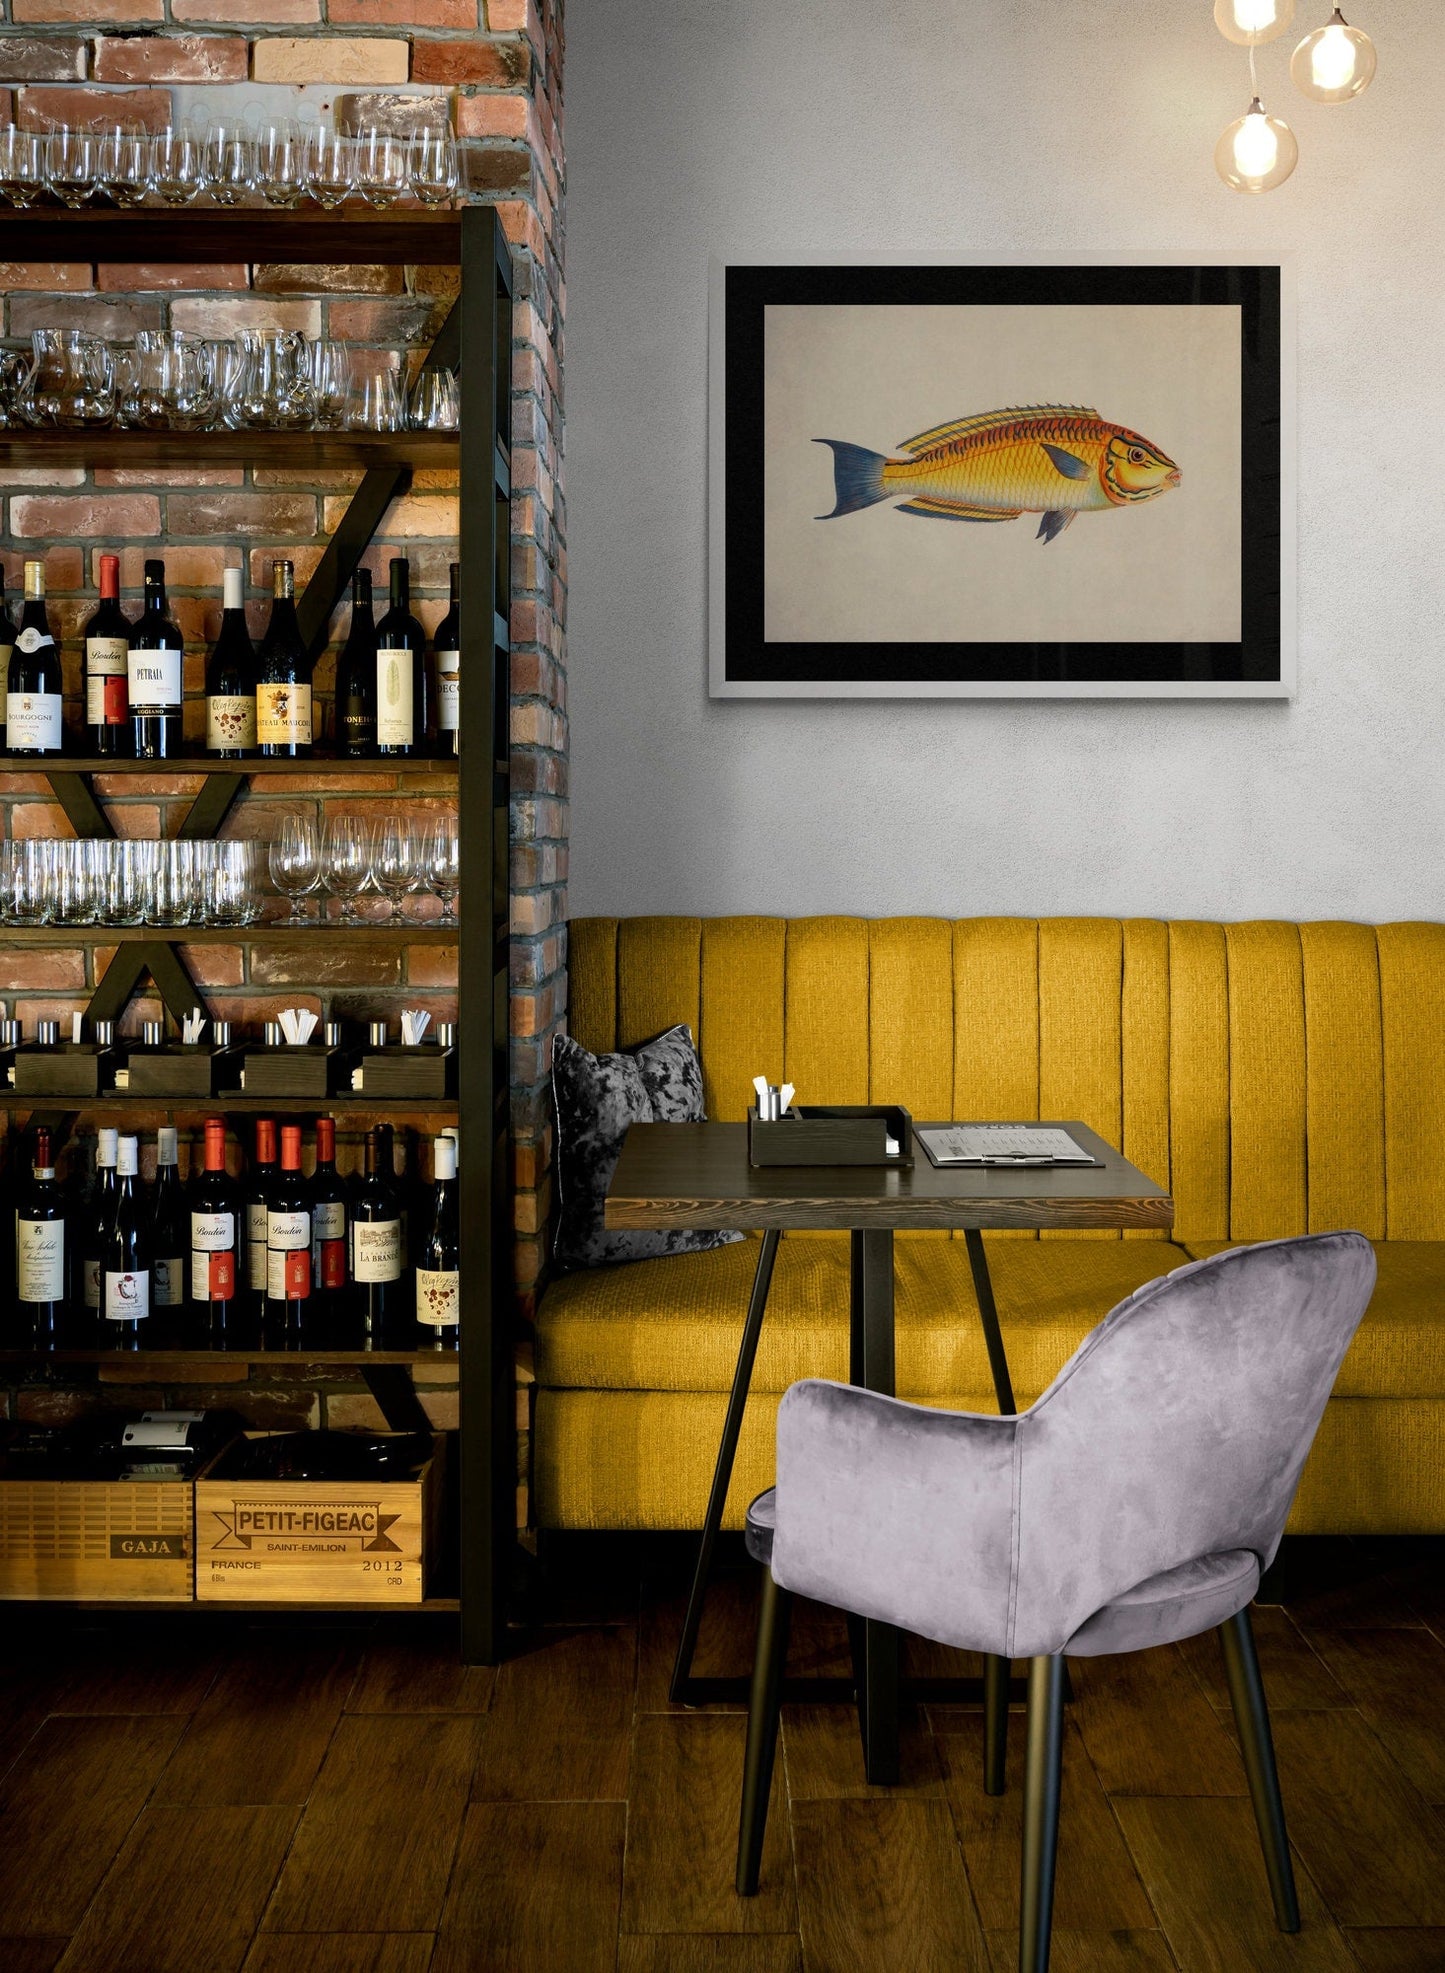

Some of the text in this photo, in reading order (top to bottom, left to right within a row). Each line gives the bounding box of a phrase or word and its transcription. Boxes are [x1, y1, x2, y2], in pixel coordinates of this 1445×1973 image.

[136, 668, 163, 680] PETRAIA
[437, 684, 461, 693] DEC
[8, 713, 53, 721] BOURGOGNE
[314, 1216, 338, 1226] ordón
[196, 1226, 226, 1236] Bordón
[272, 1225, 303, 1235] Bordón
[360, 1252, 370, 1262] LA
[239, 1511, 375, 1532] PETIT-FIGEAC
[121, 1540, 172, 1553] GAJA
[267, 1543, 346, 1552] SAINT-EMILION
[211, 1560, 262, 1569] FRANCE
[362, 1559, 403, 1572] 2012
